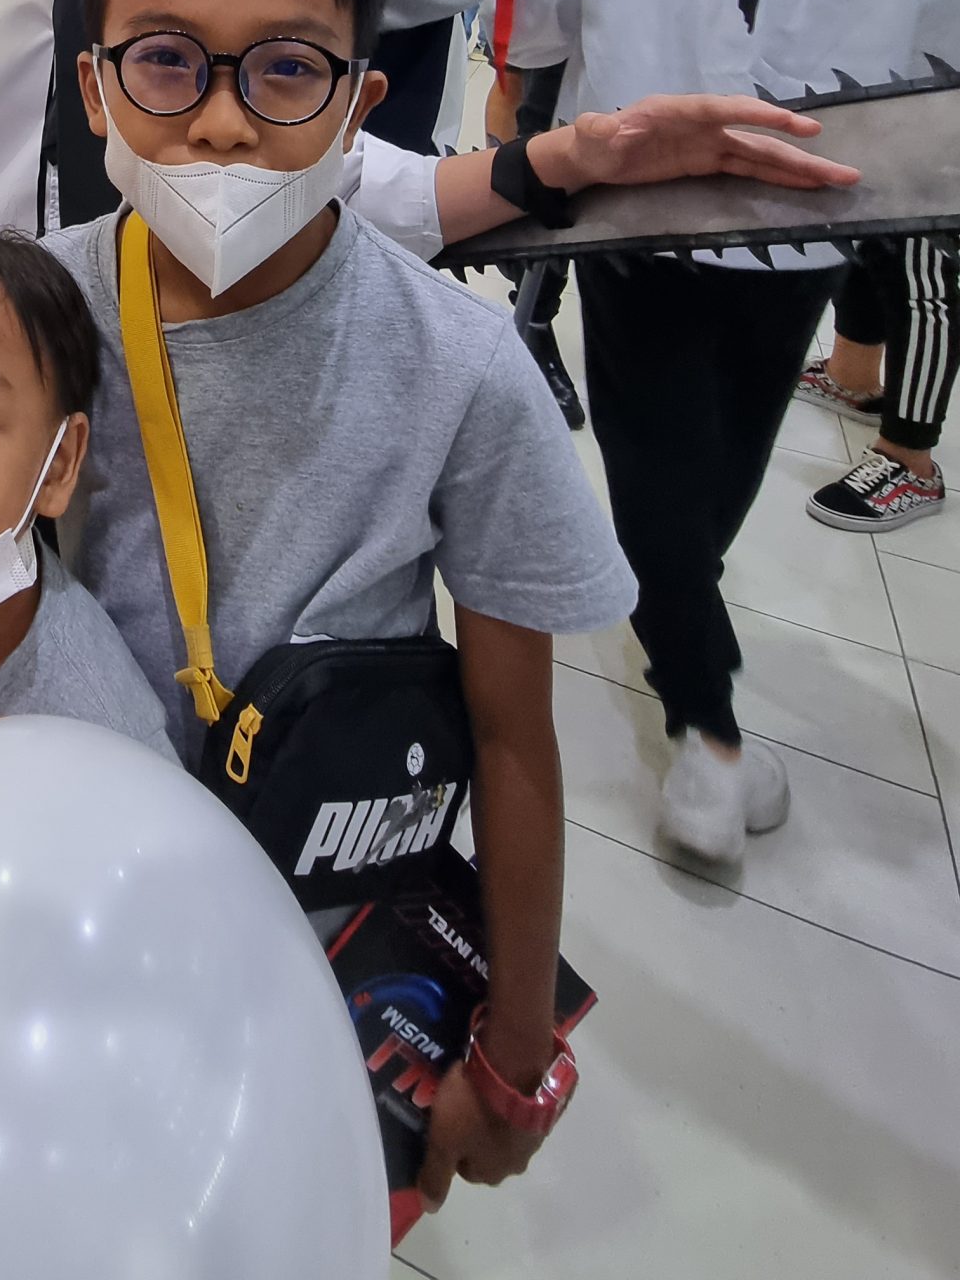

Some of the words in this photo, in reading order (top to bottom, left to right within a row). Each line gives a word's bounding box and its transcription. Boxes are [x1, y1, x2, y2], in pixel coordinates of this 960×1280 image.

[293, 781, 458, 876] PUMA
[428, 905, 473, 959] INTEL
[380, 1005, 444, 1061] MUSIM
